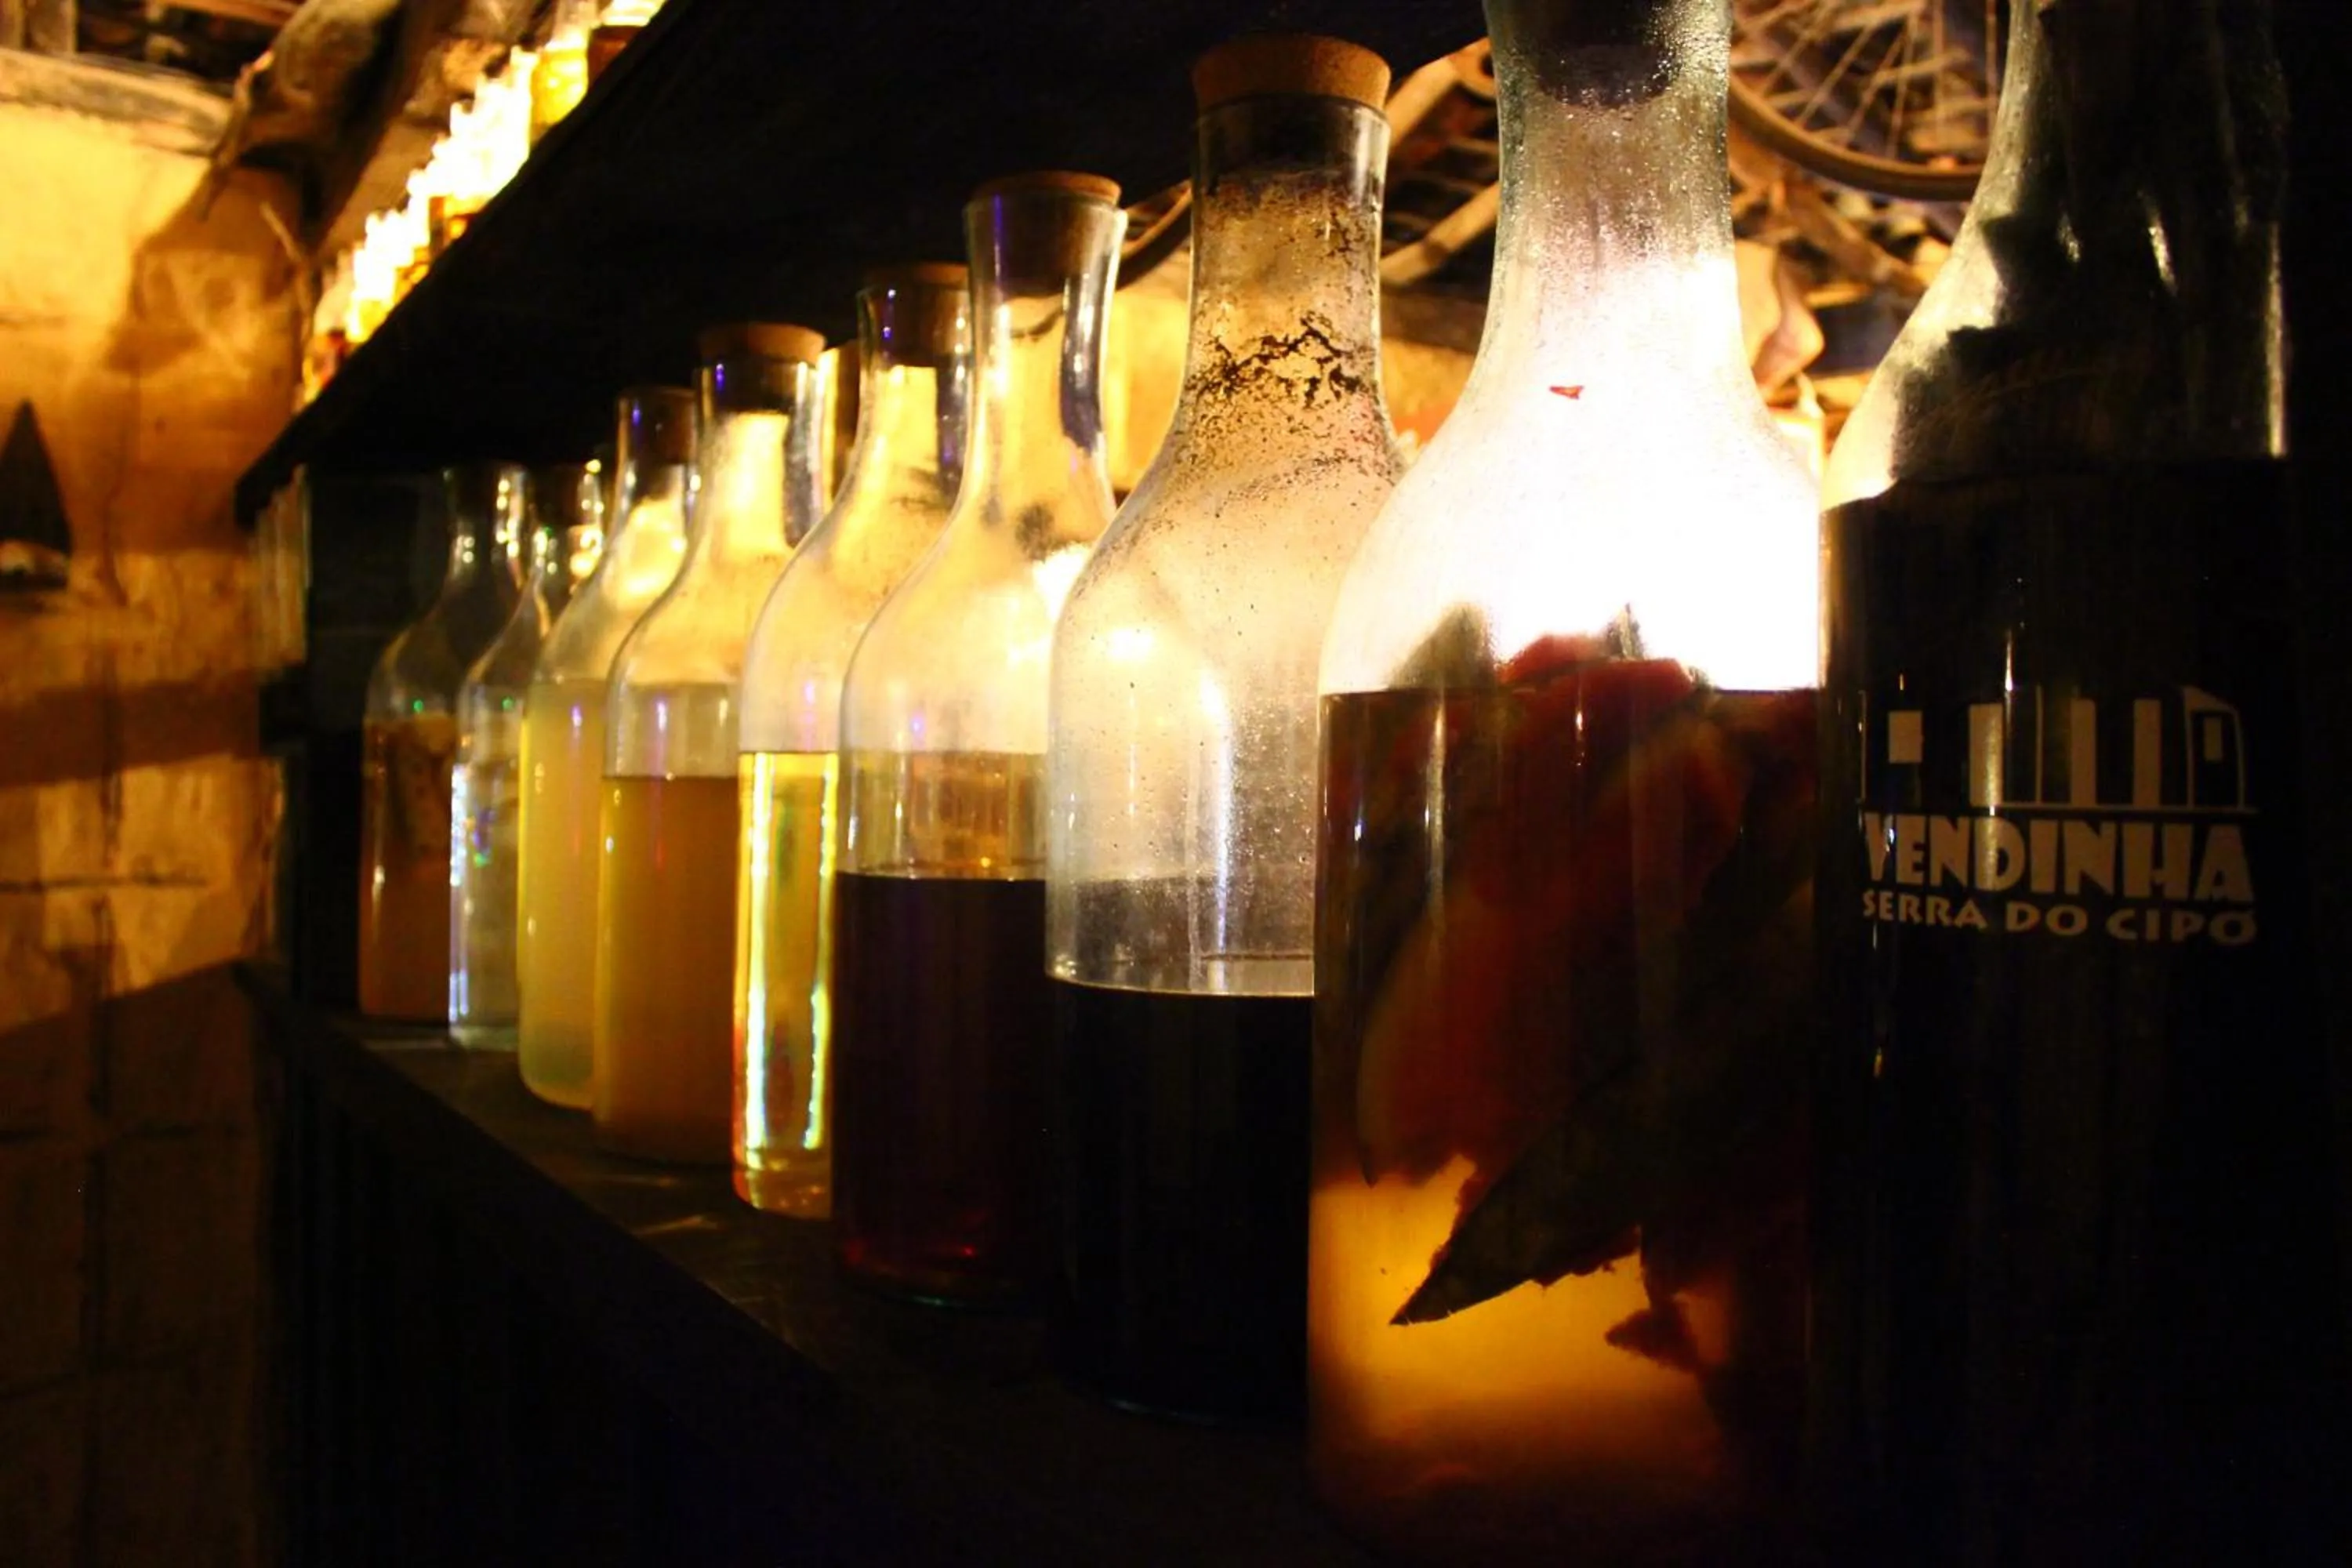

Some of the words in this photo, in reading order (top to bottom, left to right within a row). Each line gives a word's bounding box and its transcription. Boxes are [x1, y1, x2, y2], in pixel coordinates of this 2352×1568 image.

[1863, 811, 2255, 902] VENDINHA
[1862, 887, 1988, 931] SERRA
[2005, 901, 2089, 936] DO
